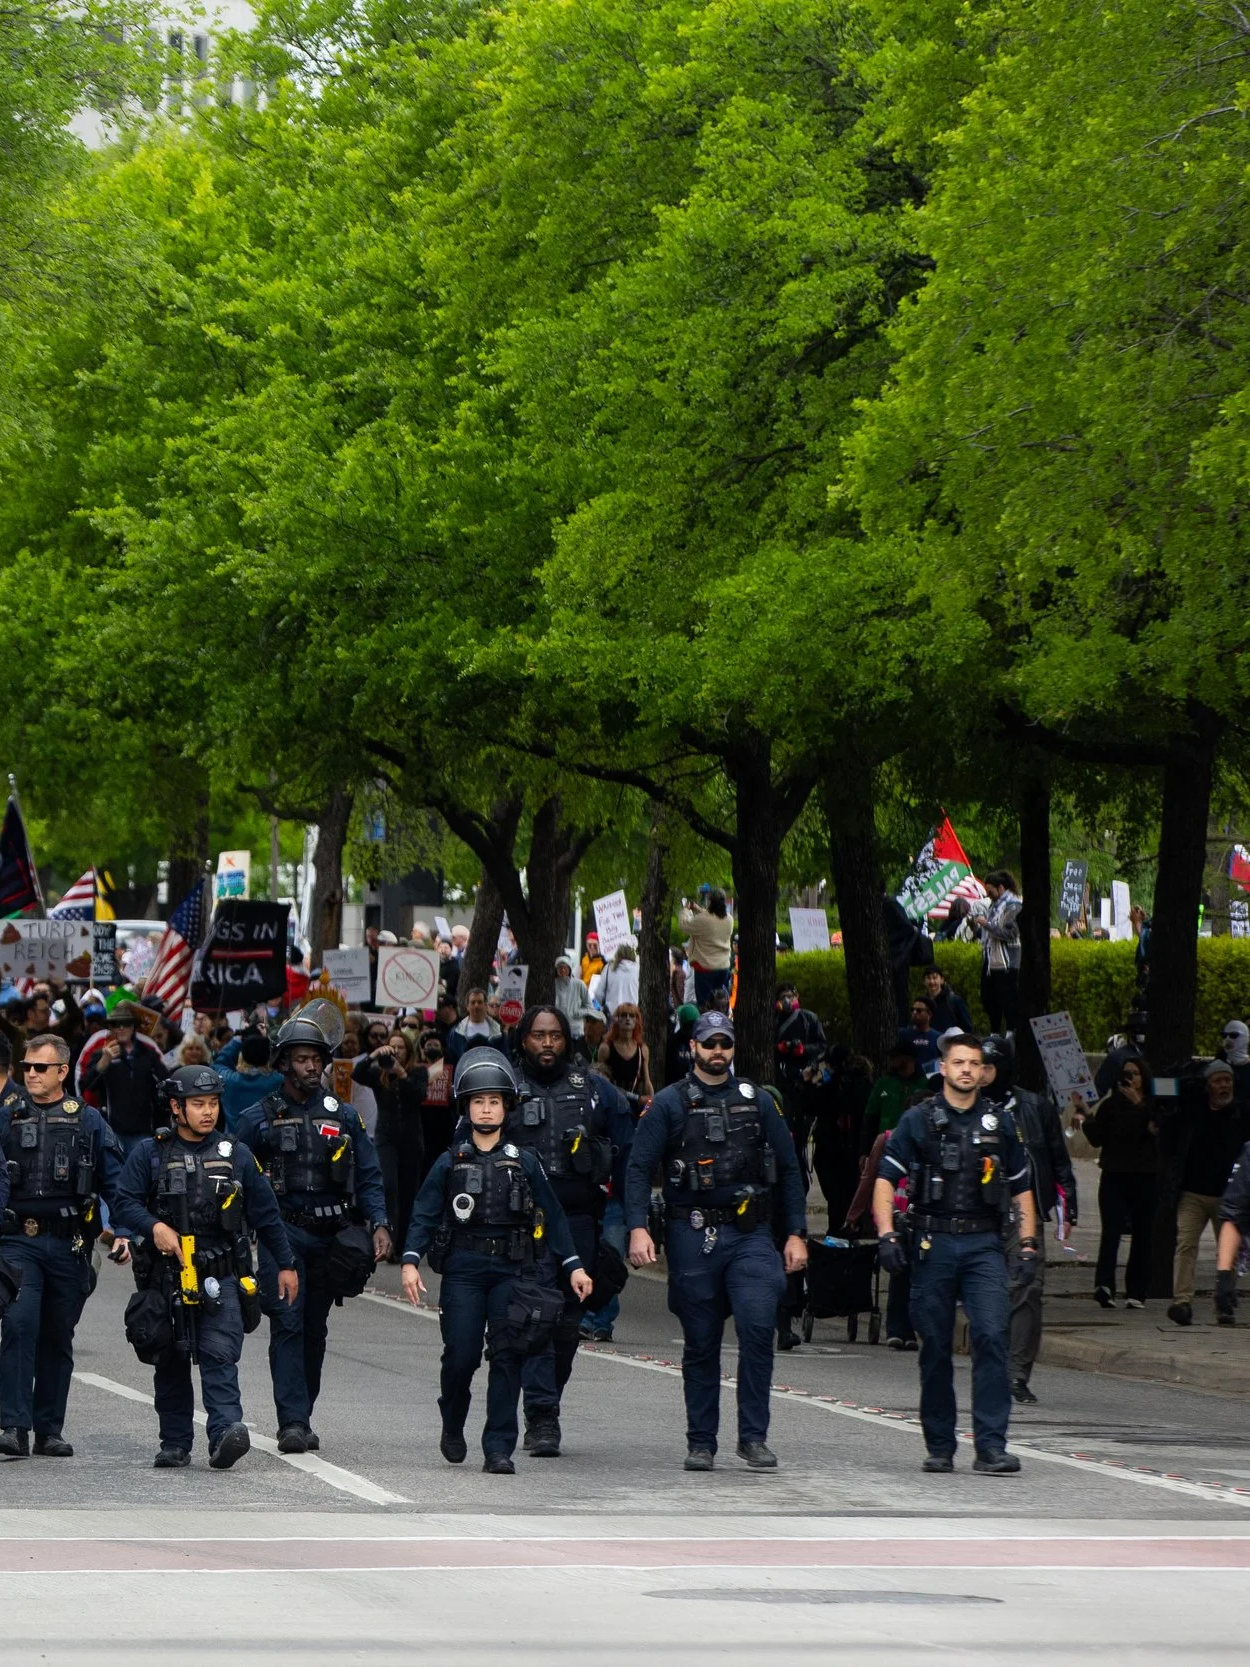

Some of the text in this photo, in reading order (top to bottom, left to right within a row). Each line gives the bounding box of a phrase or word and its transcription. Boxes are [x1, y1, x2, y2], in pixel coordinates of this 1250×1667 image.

[23, 922, 75, 939] TURD
[215, 920, 278, 941] GS IN
[14, 942, 73, 961] REICH
[205, 962, 264, 985] RICA
